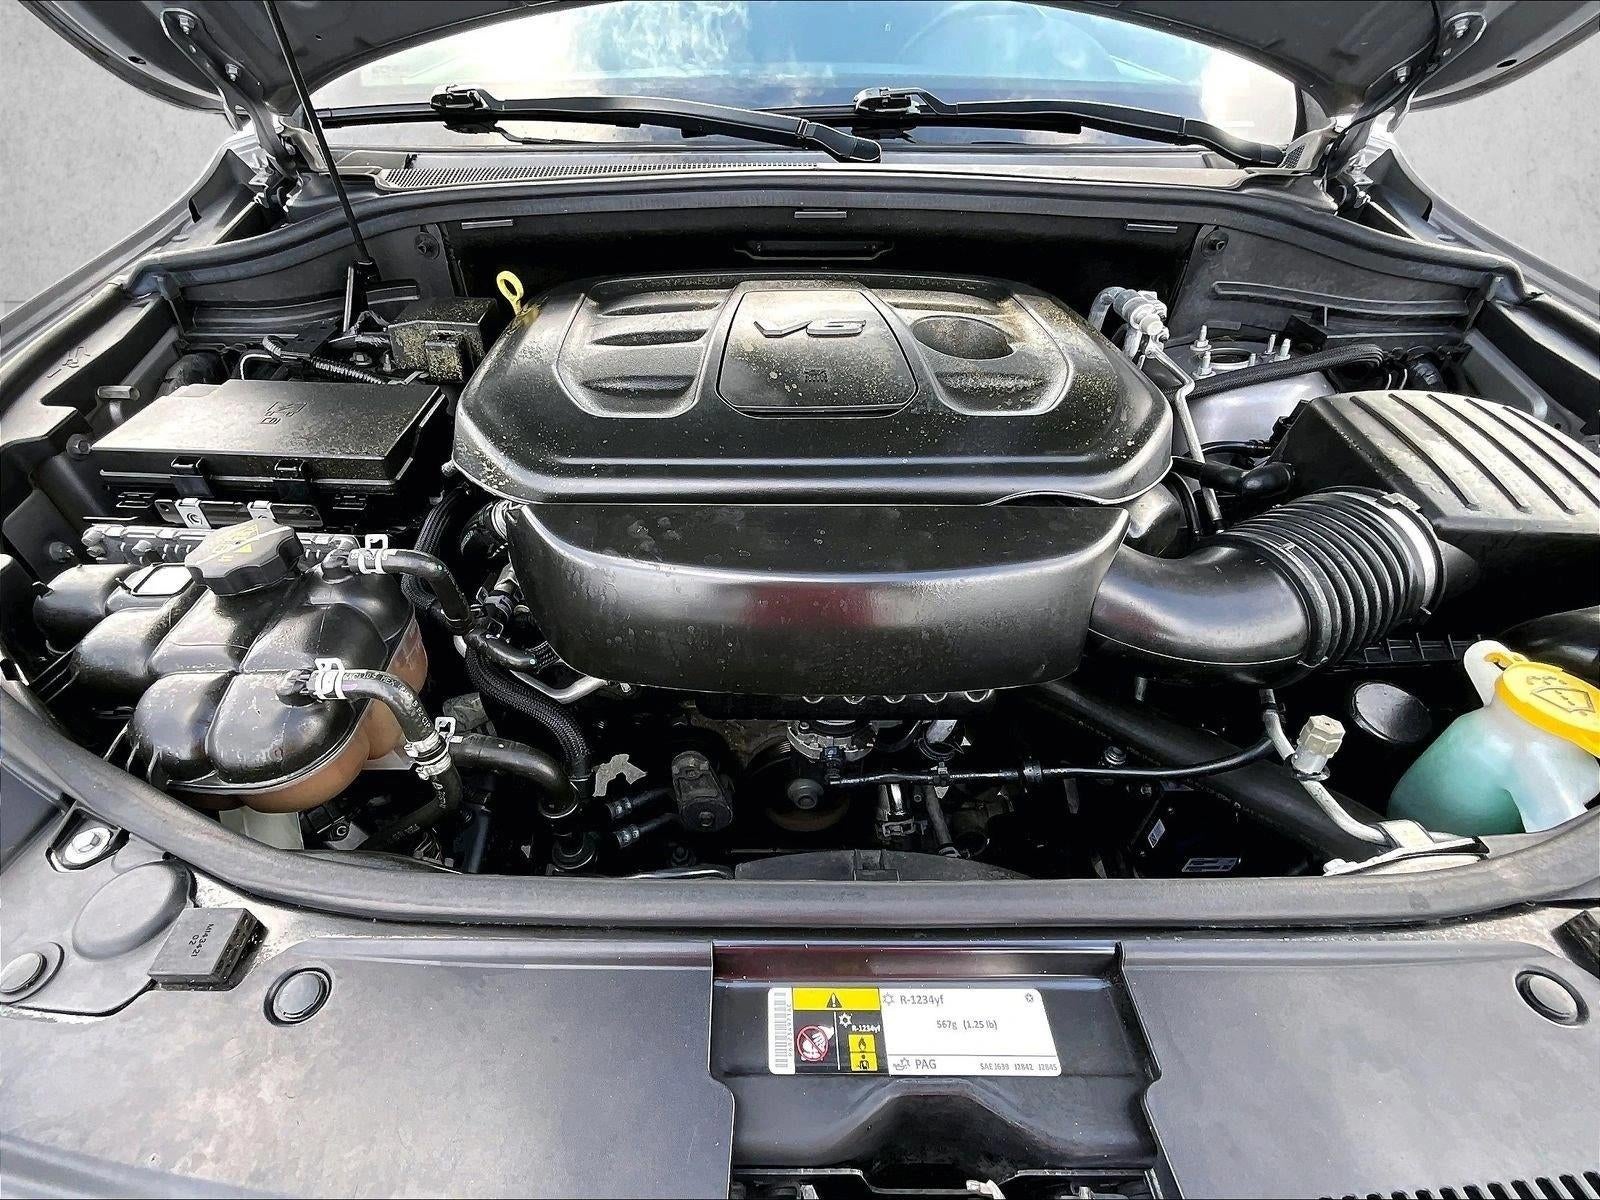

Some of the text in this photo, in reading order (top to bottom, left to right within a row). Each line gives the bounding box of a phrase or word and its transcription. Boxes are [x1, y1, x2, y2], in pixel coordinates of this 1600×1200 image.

[753, 318, 867, 338] V6
[900, 994, 944, 1007] R-1234yf
[936, 1019, 957, 1030] 567g
[963, 1019, 984, 1030] (1.25
[915, 1058, 937, 1069] PAG
